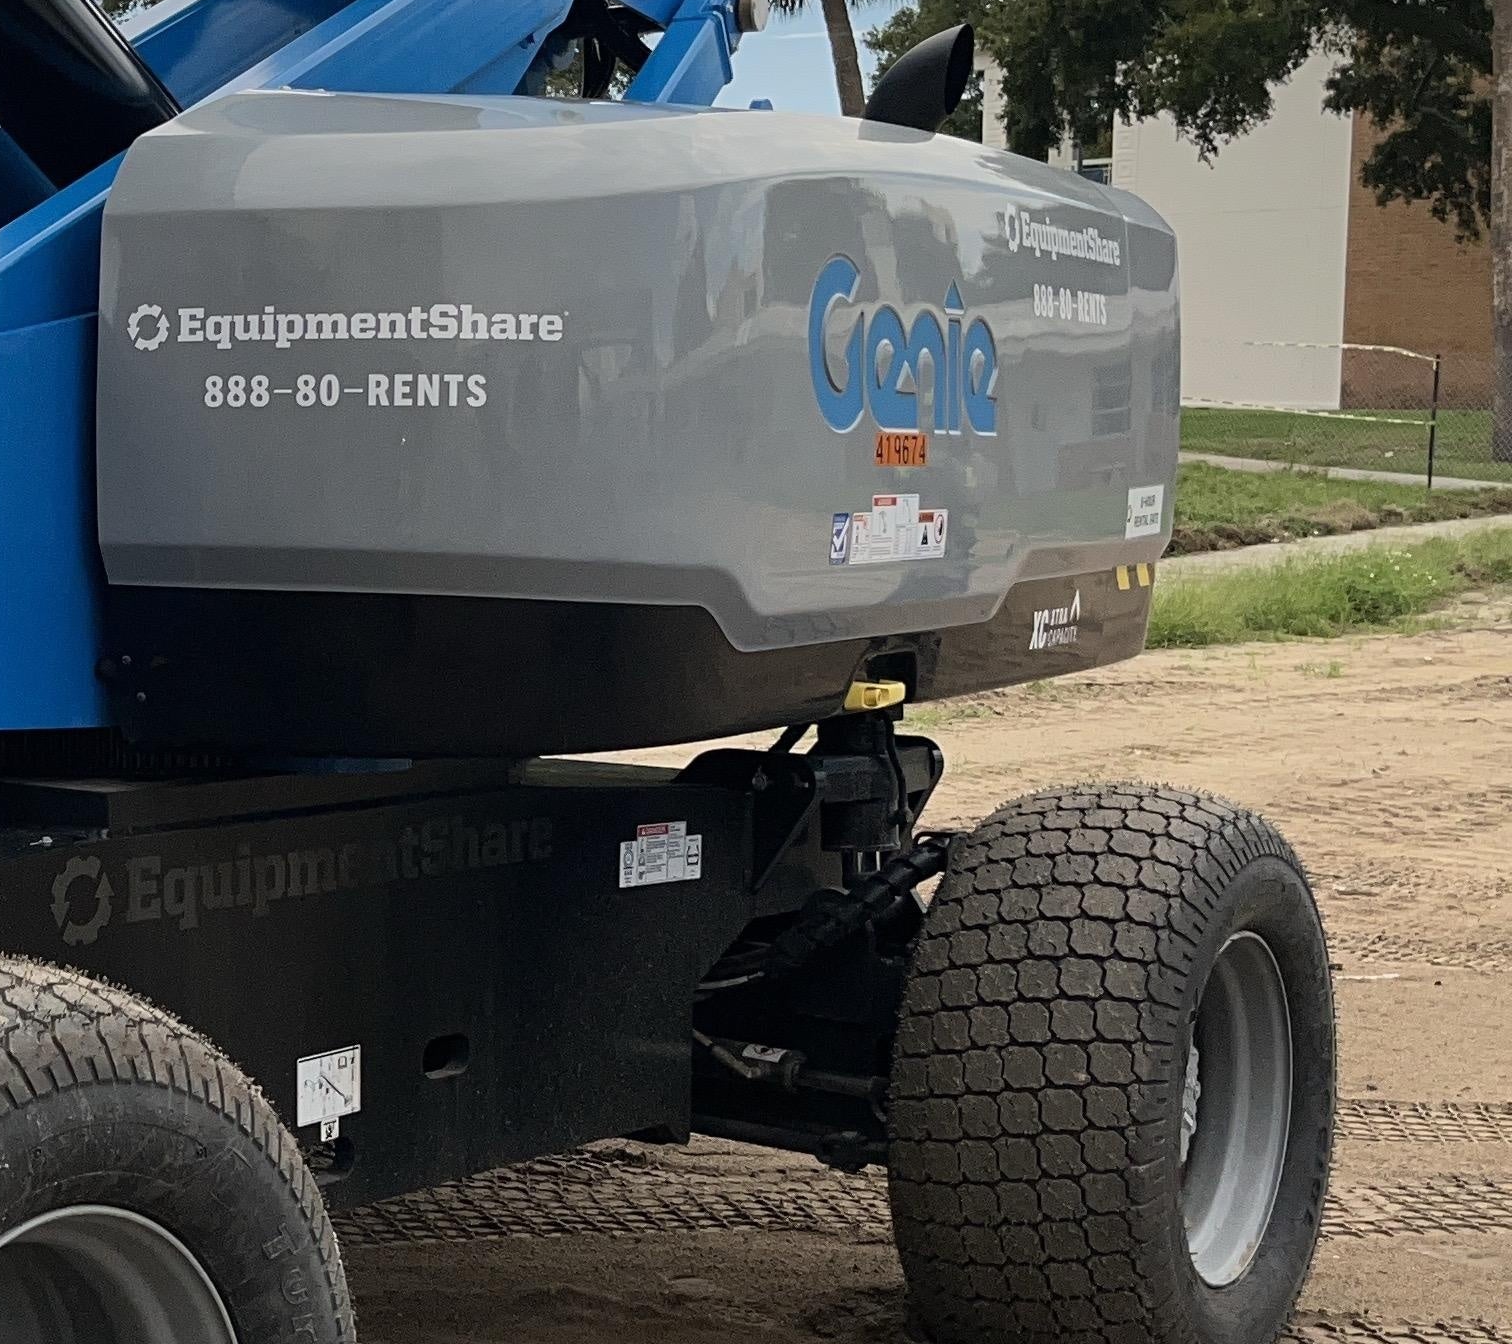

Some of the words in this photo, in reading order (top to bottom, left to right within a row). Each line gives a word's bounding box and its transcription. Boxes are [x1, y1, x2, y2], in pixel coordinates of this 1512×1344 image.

[1020, 211, 1121, 266] EquipmentShare
[1034, 283, 1107, 325] 888-80-RENTS
[177, 303, 564, 350] EquipmentShare
[808, 252, 999, 436] Genie
[203, 373, 488, 408] 888-80-RENTS
[875, 435, 926, 465] 419674
